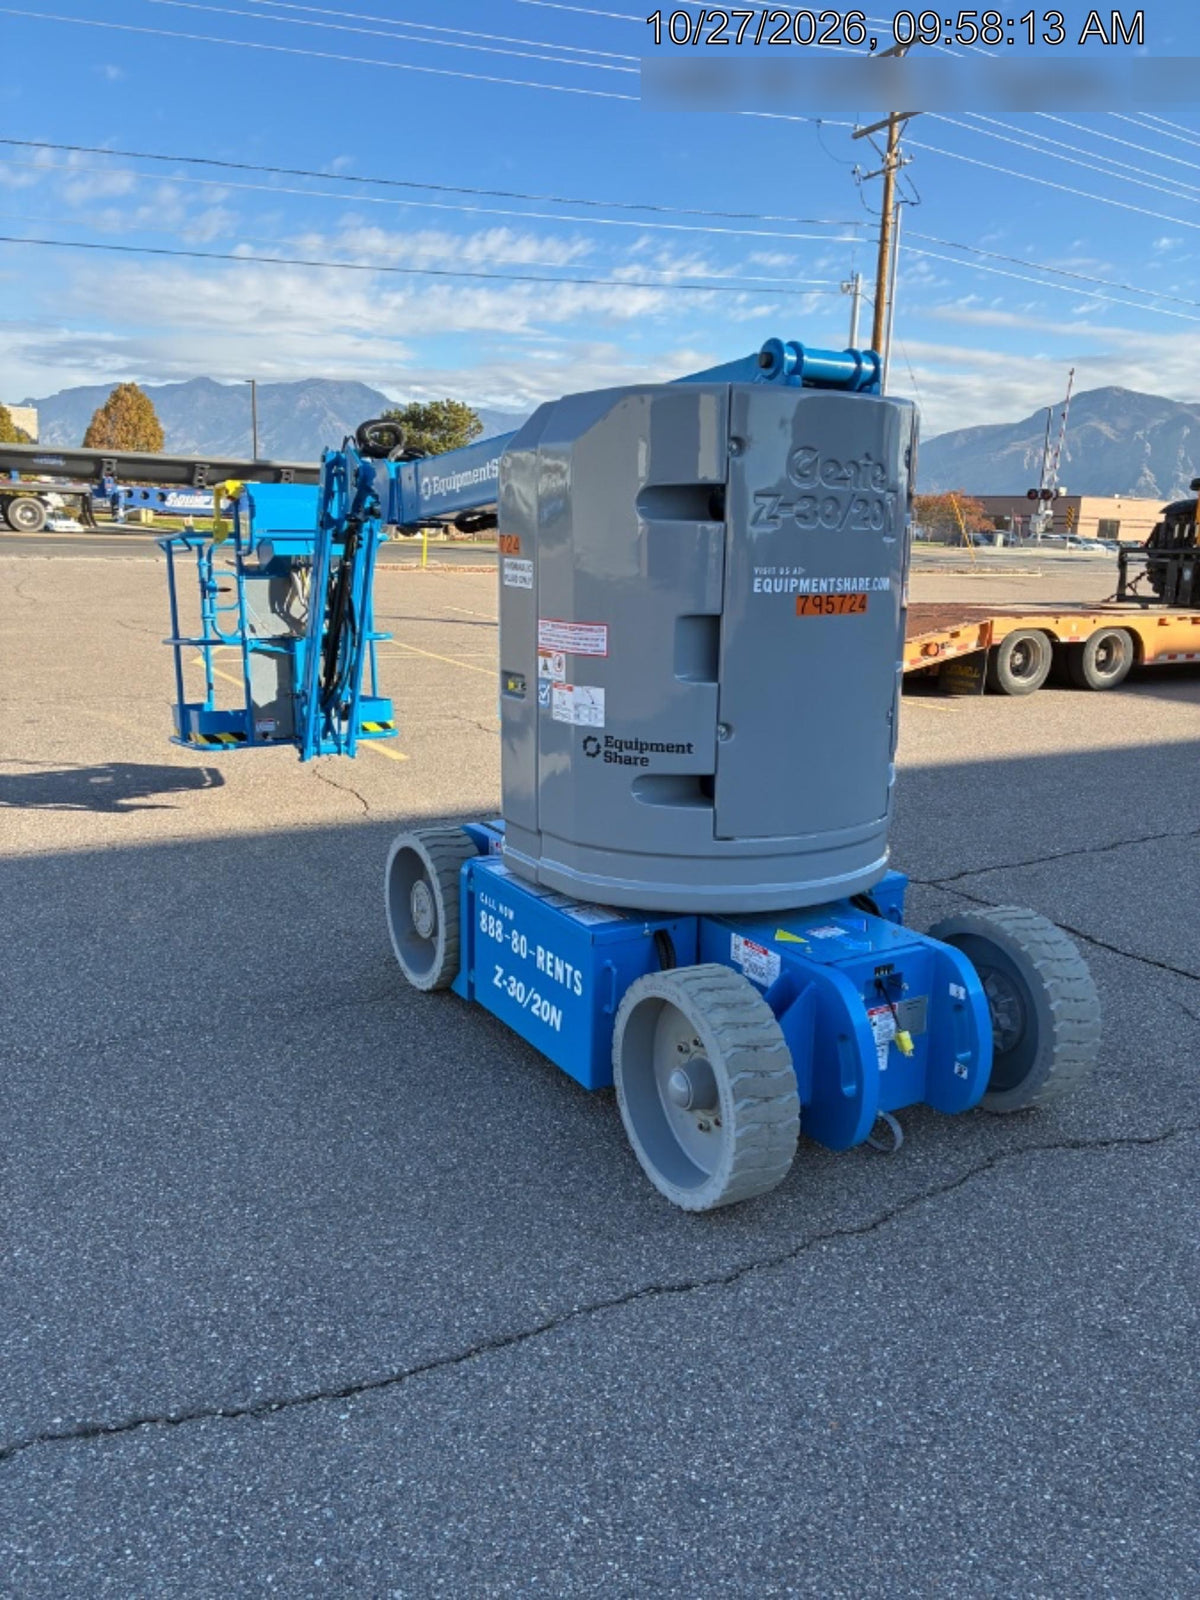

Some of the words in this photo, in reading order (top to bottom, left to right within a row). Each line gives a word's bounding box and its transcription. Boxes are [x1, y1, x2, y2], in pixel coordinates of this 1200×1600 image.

[432, 458, 499, 496] EquipmentS
[753, 577, 890, 593] EQUIPMENTSHARE.COM
[800, 594, 867, 616] 795724
[604, 735, 694, 754] Equipment
[603, 750, 650, 767] Share
[480, 892, 497, 911] CALL
[499, 903, 514, 920] NOW
[480, 910, 583, 997] 888-80-RENTS
[493, 965, 562, 1032] Z-30/20N
